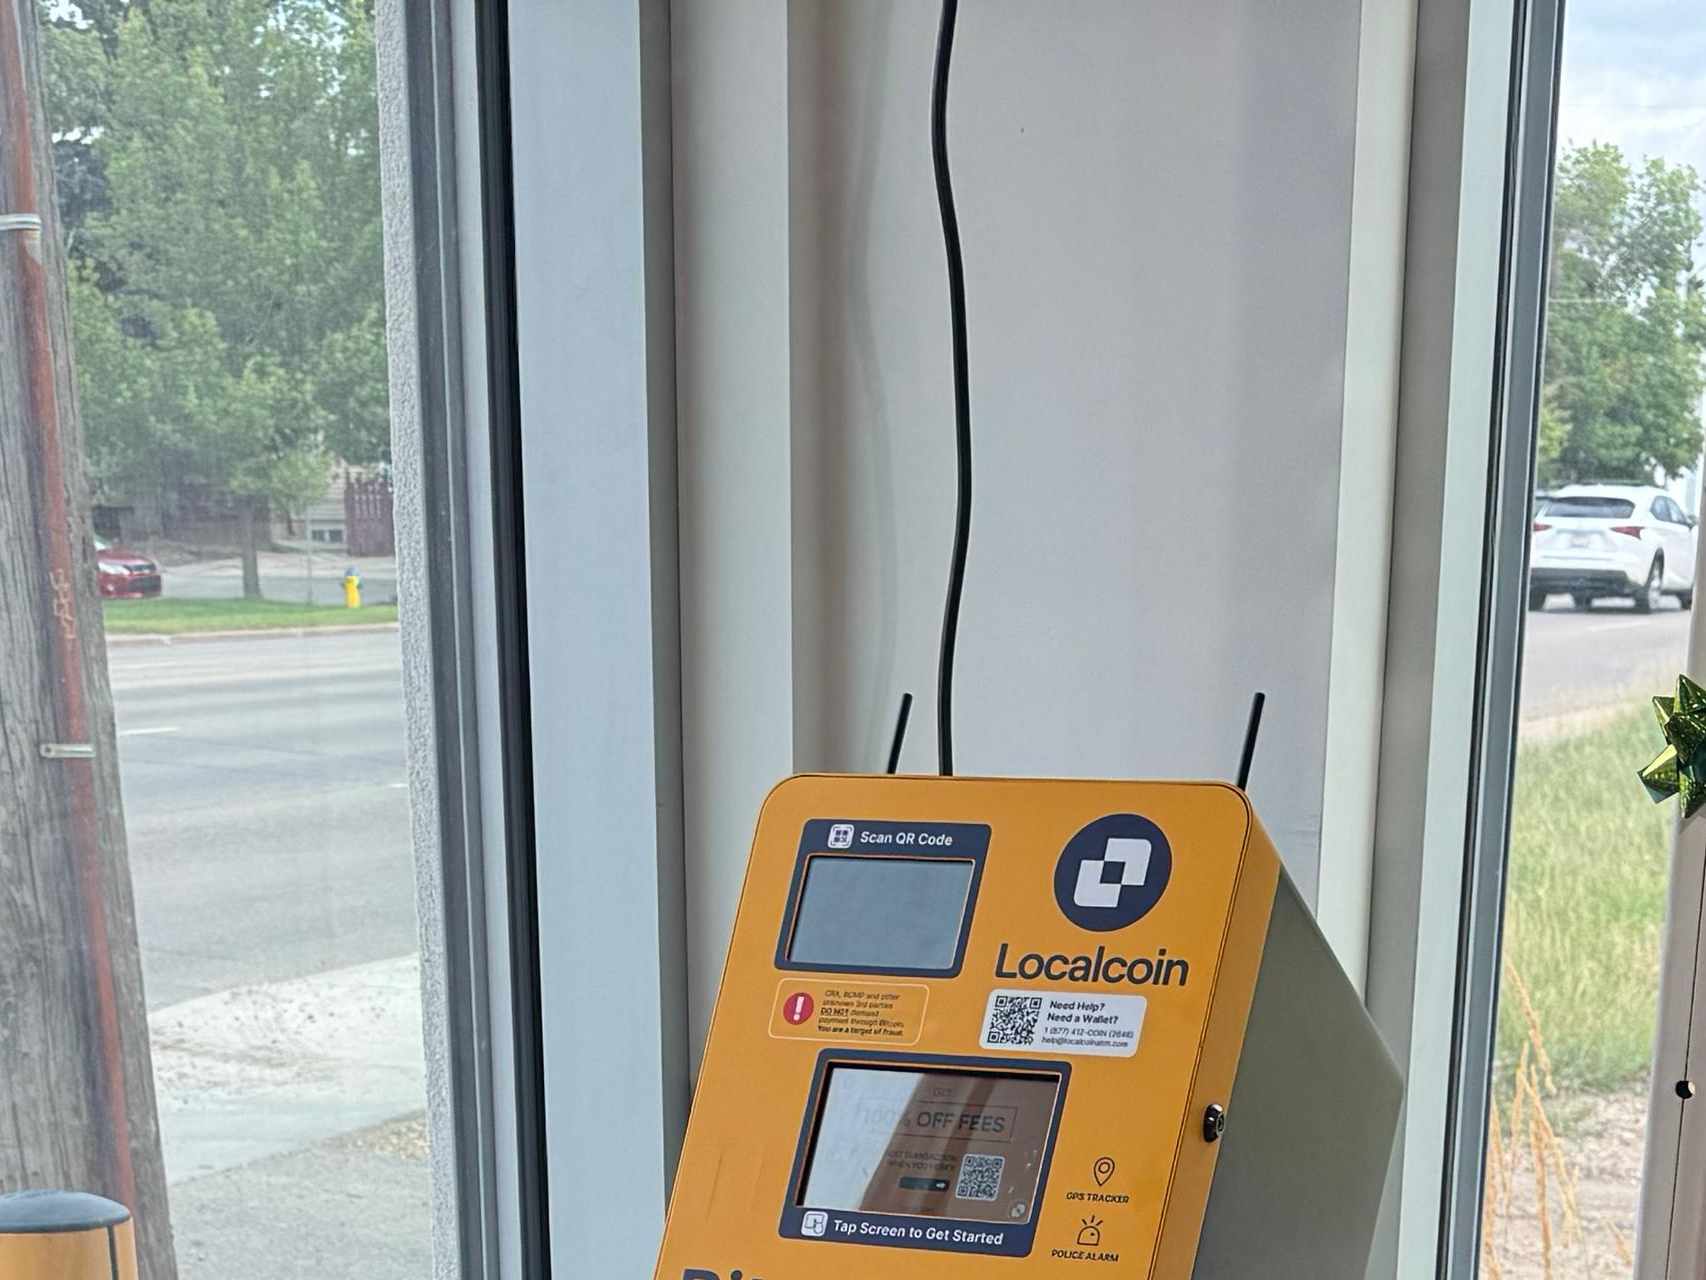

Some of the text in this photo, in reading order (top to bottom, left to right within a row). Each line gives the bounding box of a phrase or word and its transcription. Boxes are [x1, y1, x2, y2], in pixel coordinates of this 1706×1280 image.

[860, 831, 953, 847] Scan QR Code
[995, 944, 1190, 987] Localcoin
[1050, 1001, 1105, 1012] Need Help?
[1047, 1013, 1072, 1023] Need
[1083, 1015, 1119, 1025] Wallet?
[917, 1111, 1005, 1133] OFF FEES
[1066, 1192, 1129, 1203] GPS TRACKER
[834, 1220, 1003, 1245] Tap Screen to Get Started
[1052, 1250, 1119, 1262] POLICE ALARM
